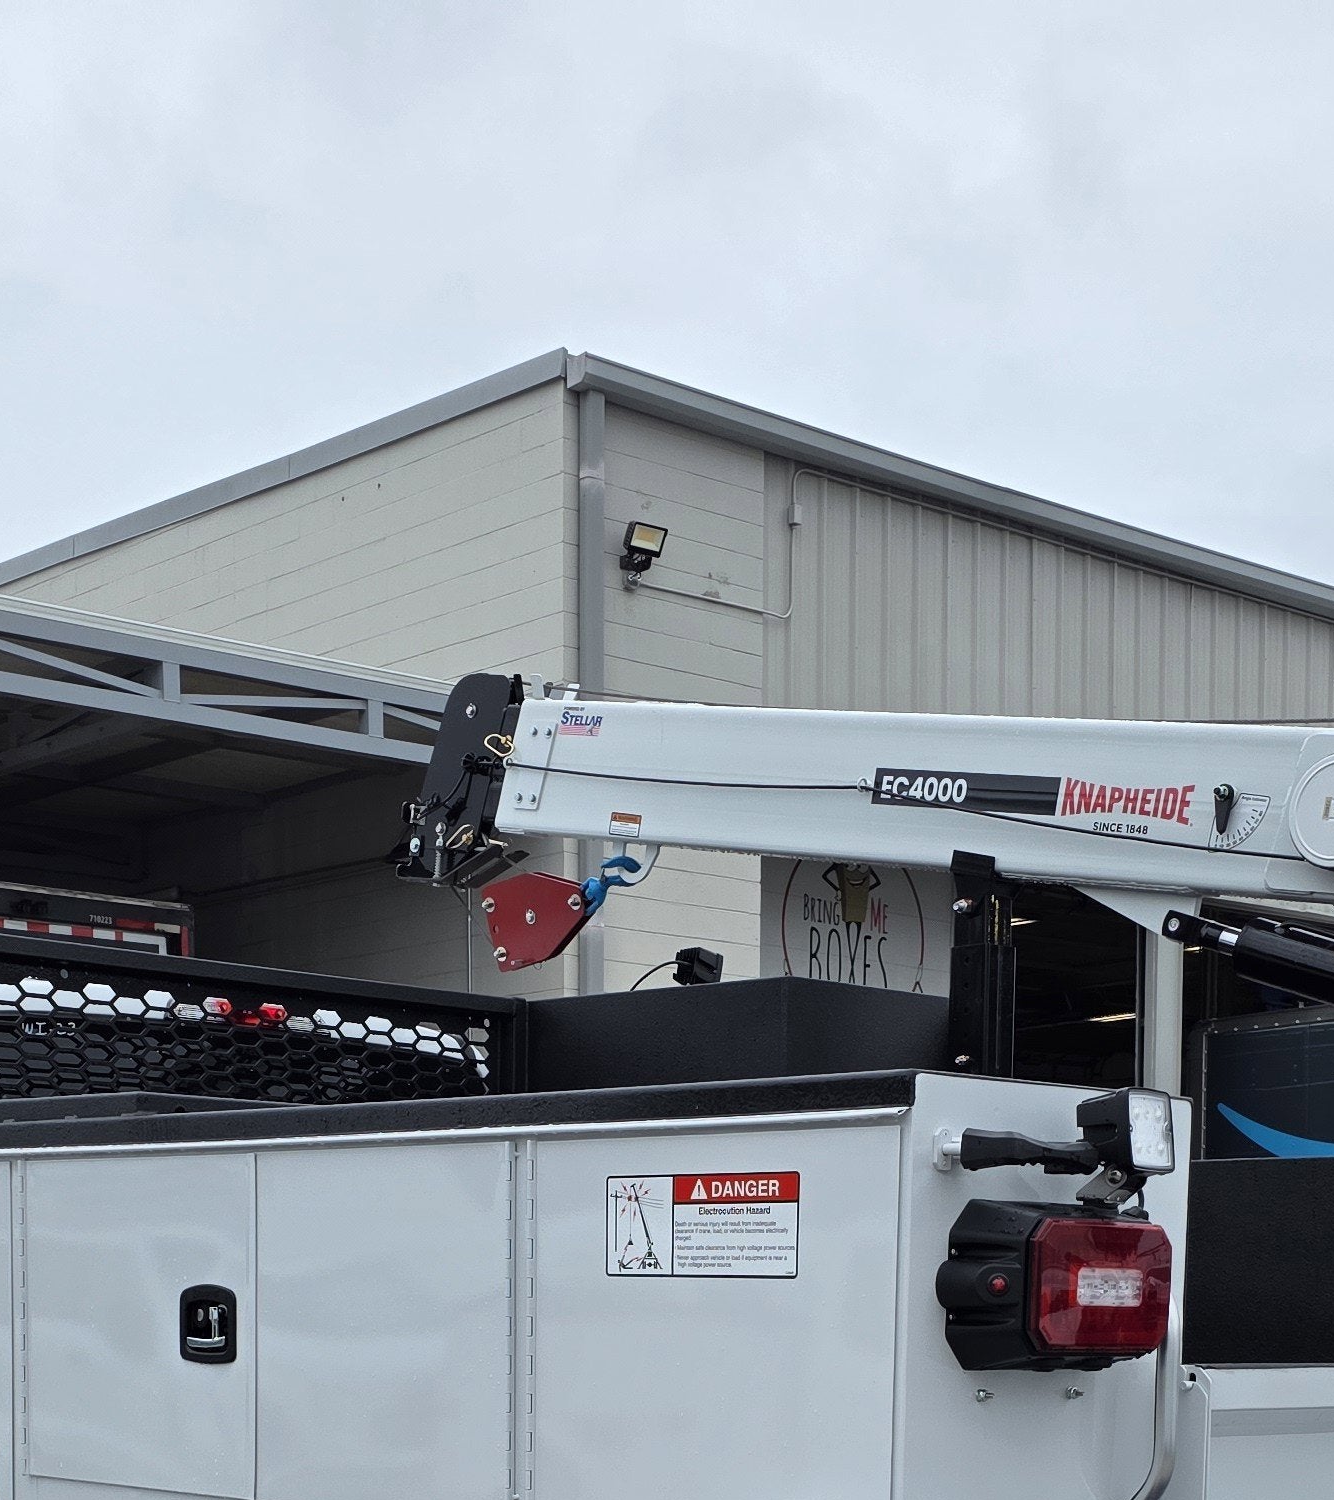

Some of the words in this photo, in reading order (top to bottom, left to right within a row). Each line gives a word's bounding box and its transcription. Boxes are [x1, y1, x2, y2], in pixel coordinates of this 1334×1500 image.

[560, 710, 603, 727] STELLAR
[880, 775, 967, 803] EC4000
[1061, 776, 1196, 826] KNAPHEIDE
[1092, 821, 1123, 833] SINCE
[1125, 824, 1149, 835] 1848
[803, 893, 840, 926] BRING
[870, 897, 889, 935] ME
[808, 926, 888, 988] BOXES
[711, 1180, 780, 1198] DANGER
[698, 1206, 745, 1216] Electrocution
[746, 1205, 771, 1215] Hazard
